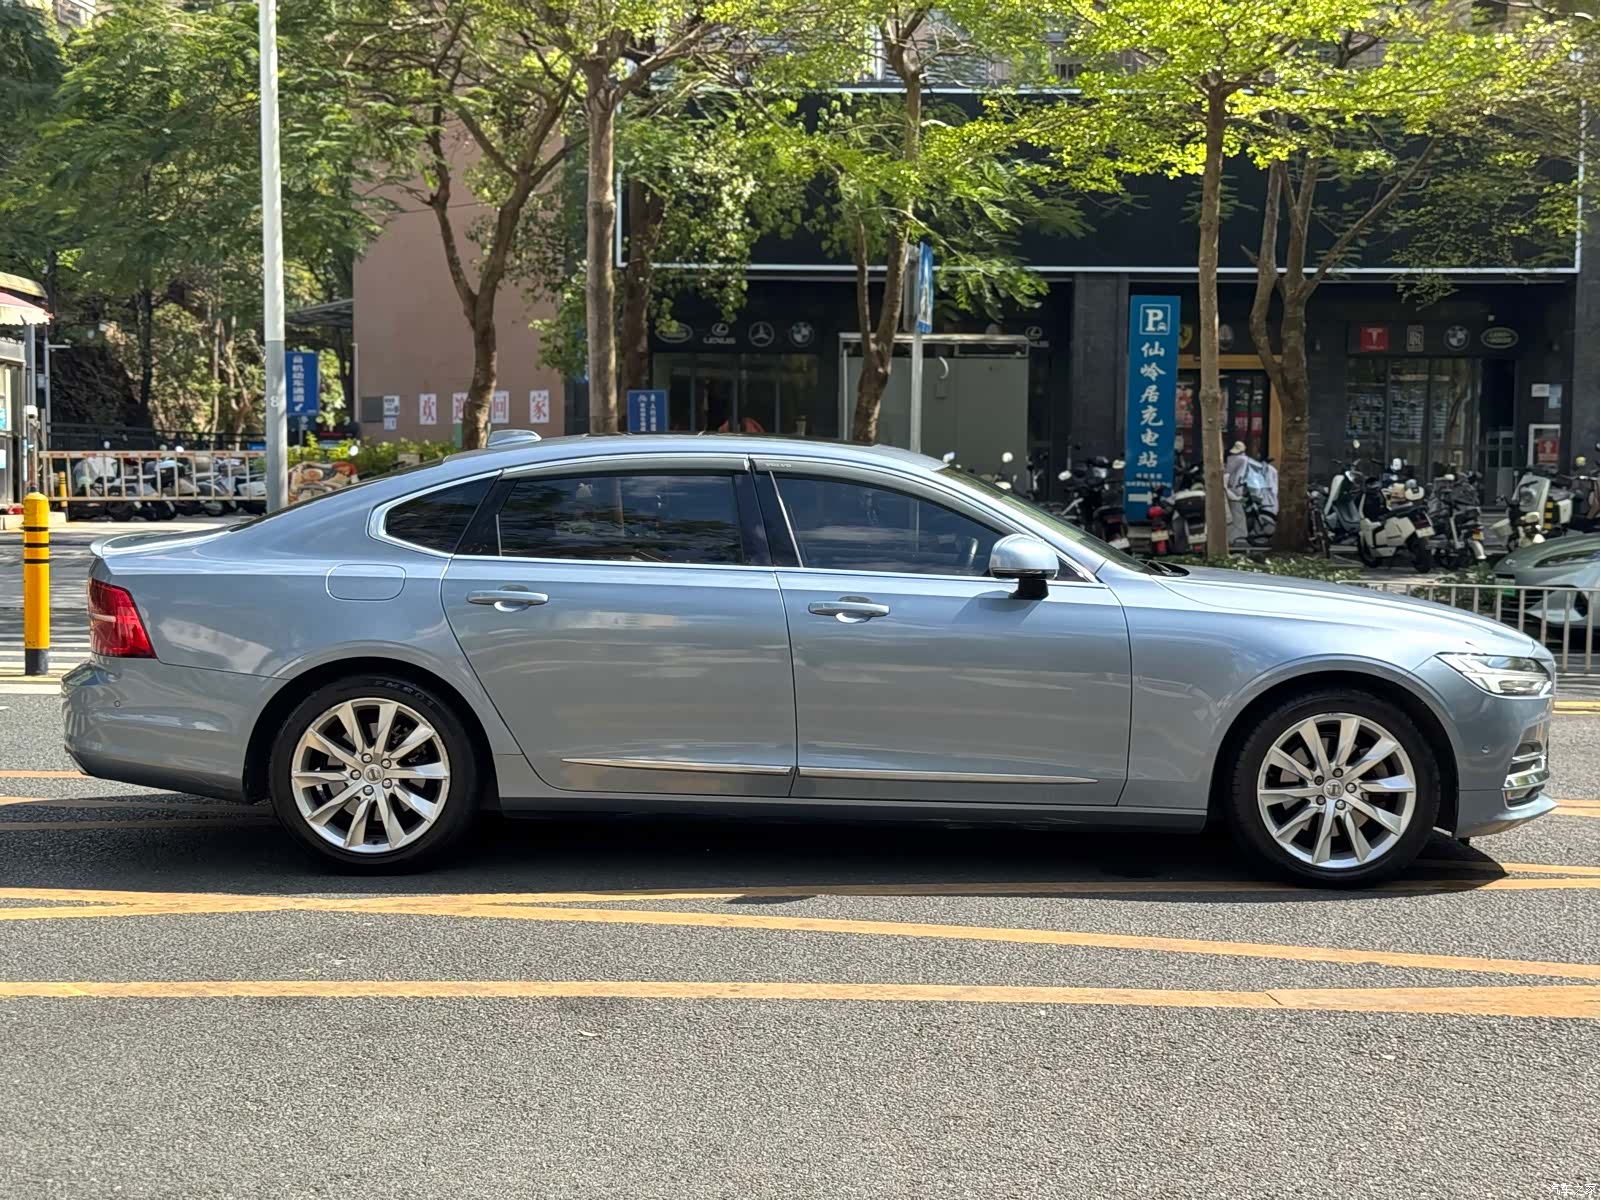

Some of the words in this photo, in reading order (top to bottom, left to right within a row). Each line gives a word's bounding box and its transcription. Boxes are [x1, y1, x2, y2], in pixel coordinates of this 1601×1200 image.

[1145, 309, 1164, 332] P
[1137, 341, 1167, 468] 仙岭居充电站
